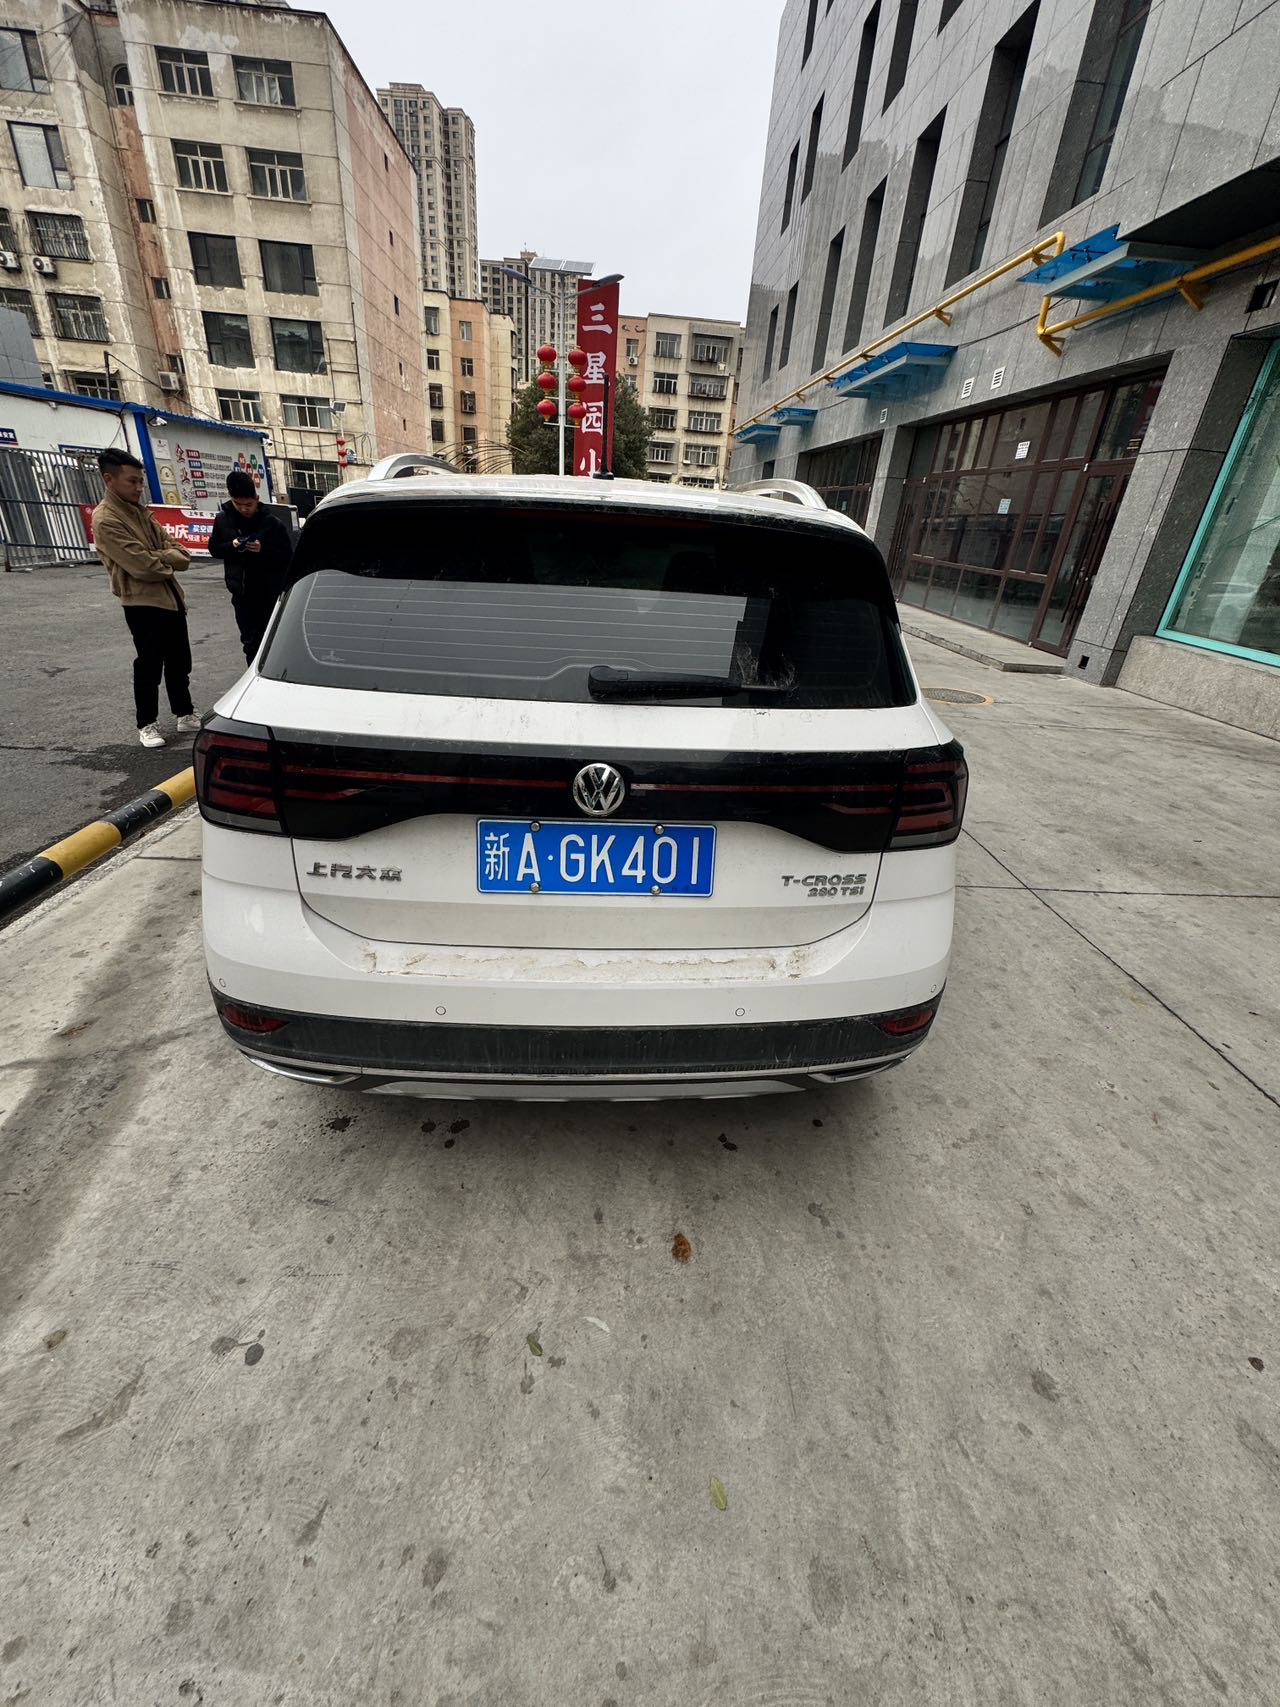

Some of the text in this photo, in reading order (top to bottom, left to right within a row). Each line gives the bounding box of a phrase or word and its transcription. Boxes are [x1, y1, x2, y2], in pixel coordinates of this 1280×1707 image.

[306, 862, 402, 881] 上汽大众
[782, 874, 867, 886] T-CROSS
[808, 886, 865, 897] 280 TSI
